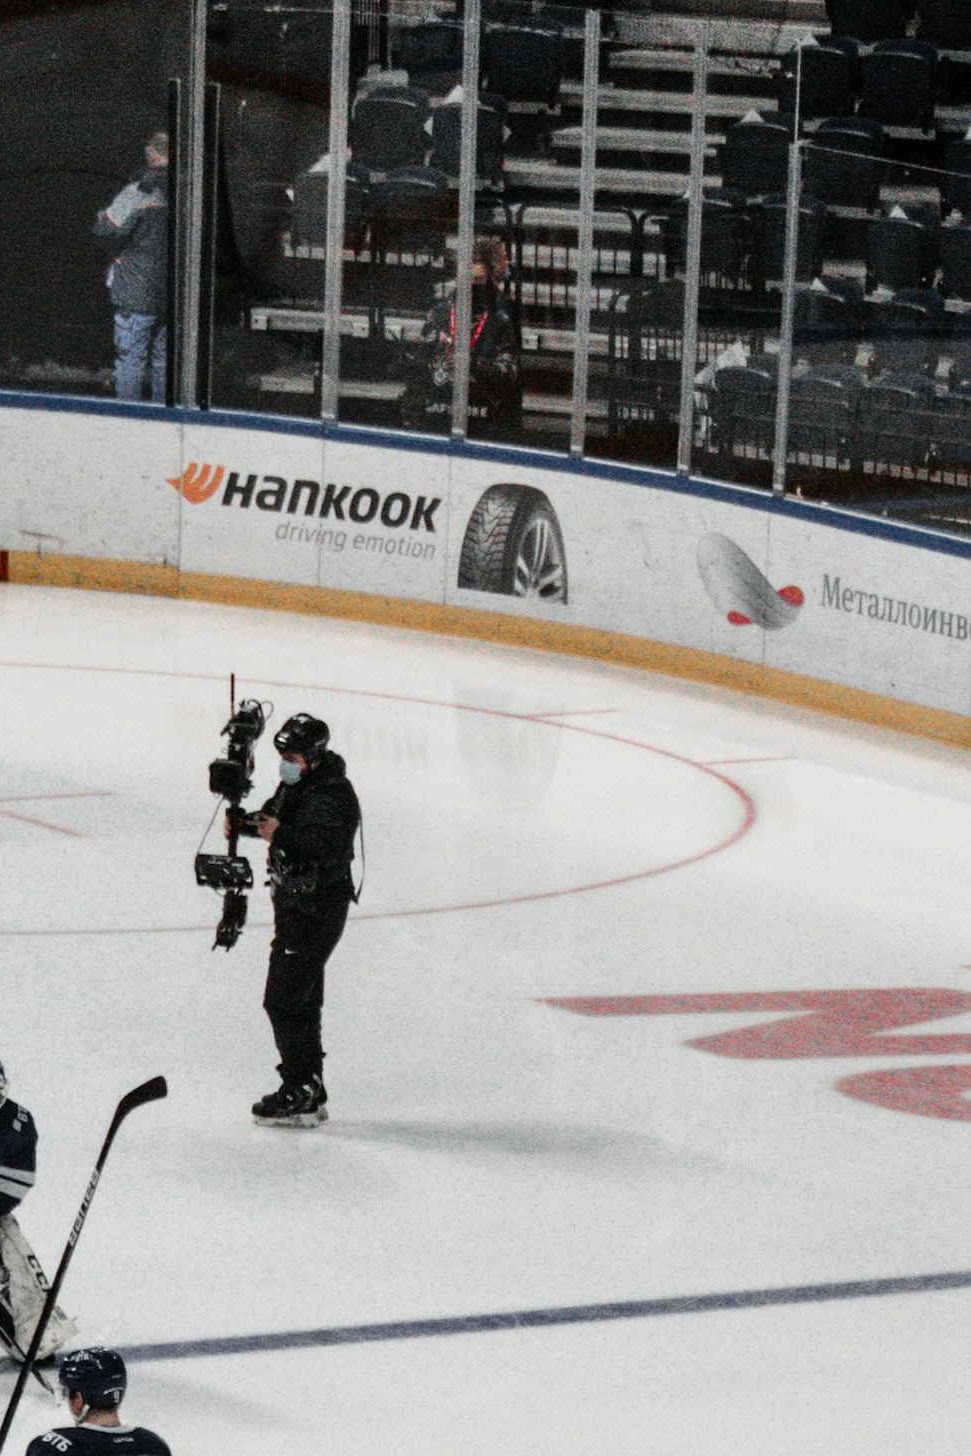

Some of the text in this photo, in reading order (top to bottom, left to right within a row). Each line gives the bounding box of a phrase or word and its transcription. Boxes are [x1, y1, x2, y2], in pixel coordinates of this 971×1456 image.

[275, 520, 436, 560] driving emotion
[820, 573, 971, 641] Металлоинв
[27, 1254, 53, 1293] CC
